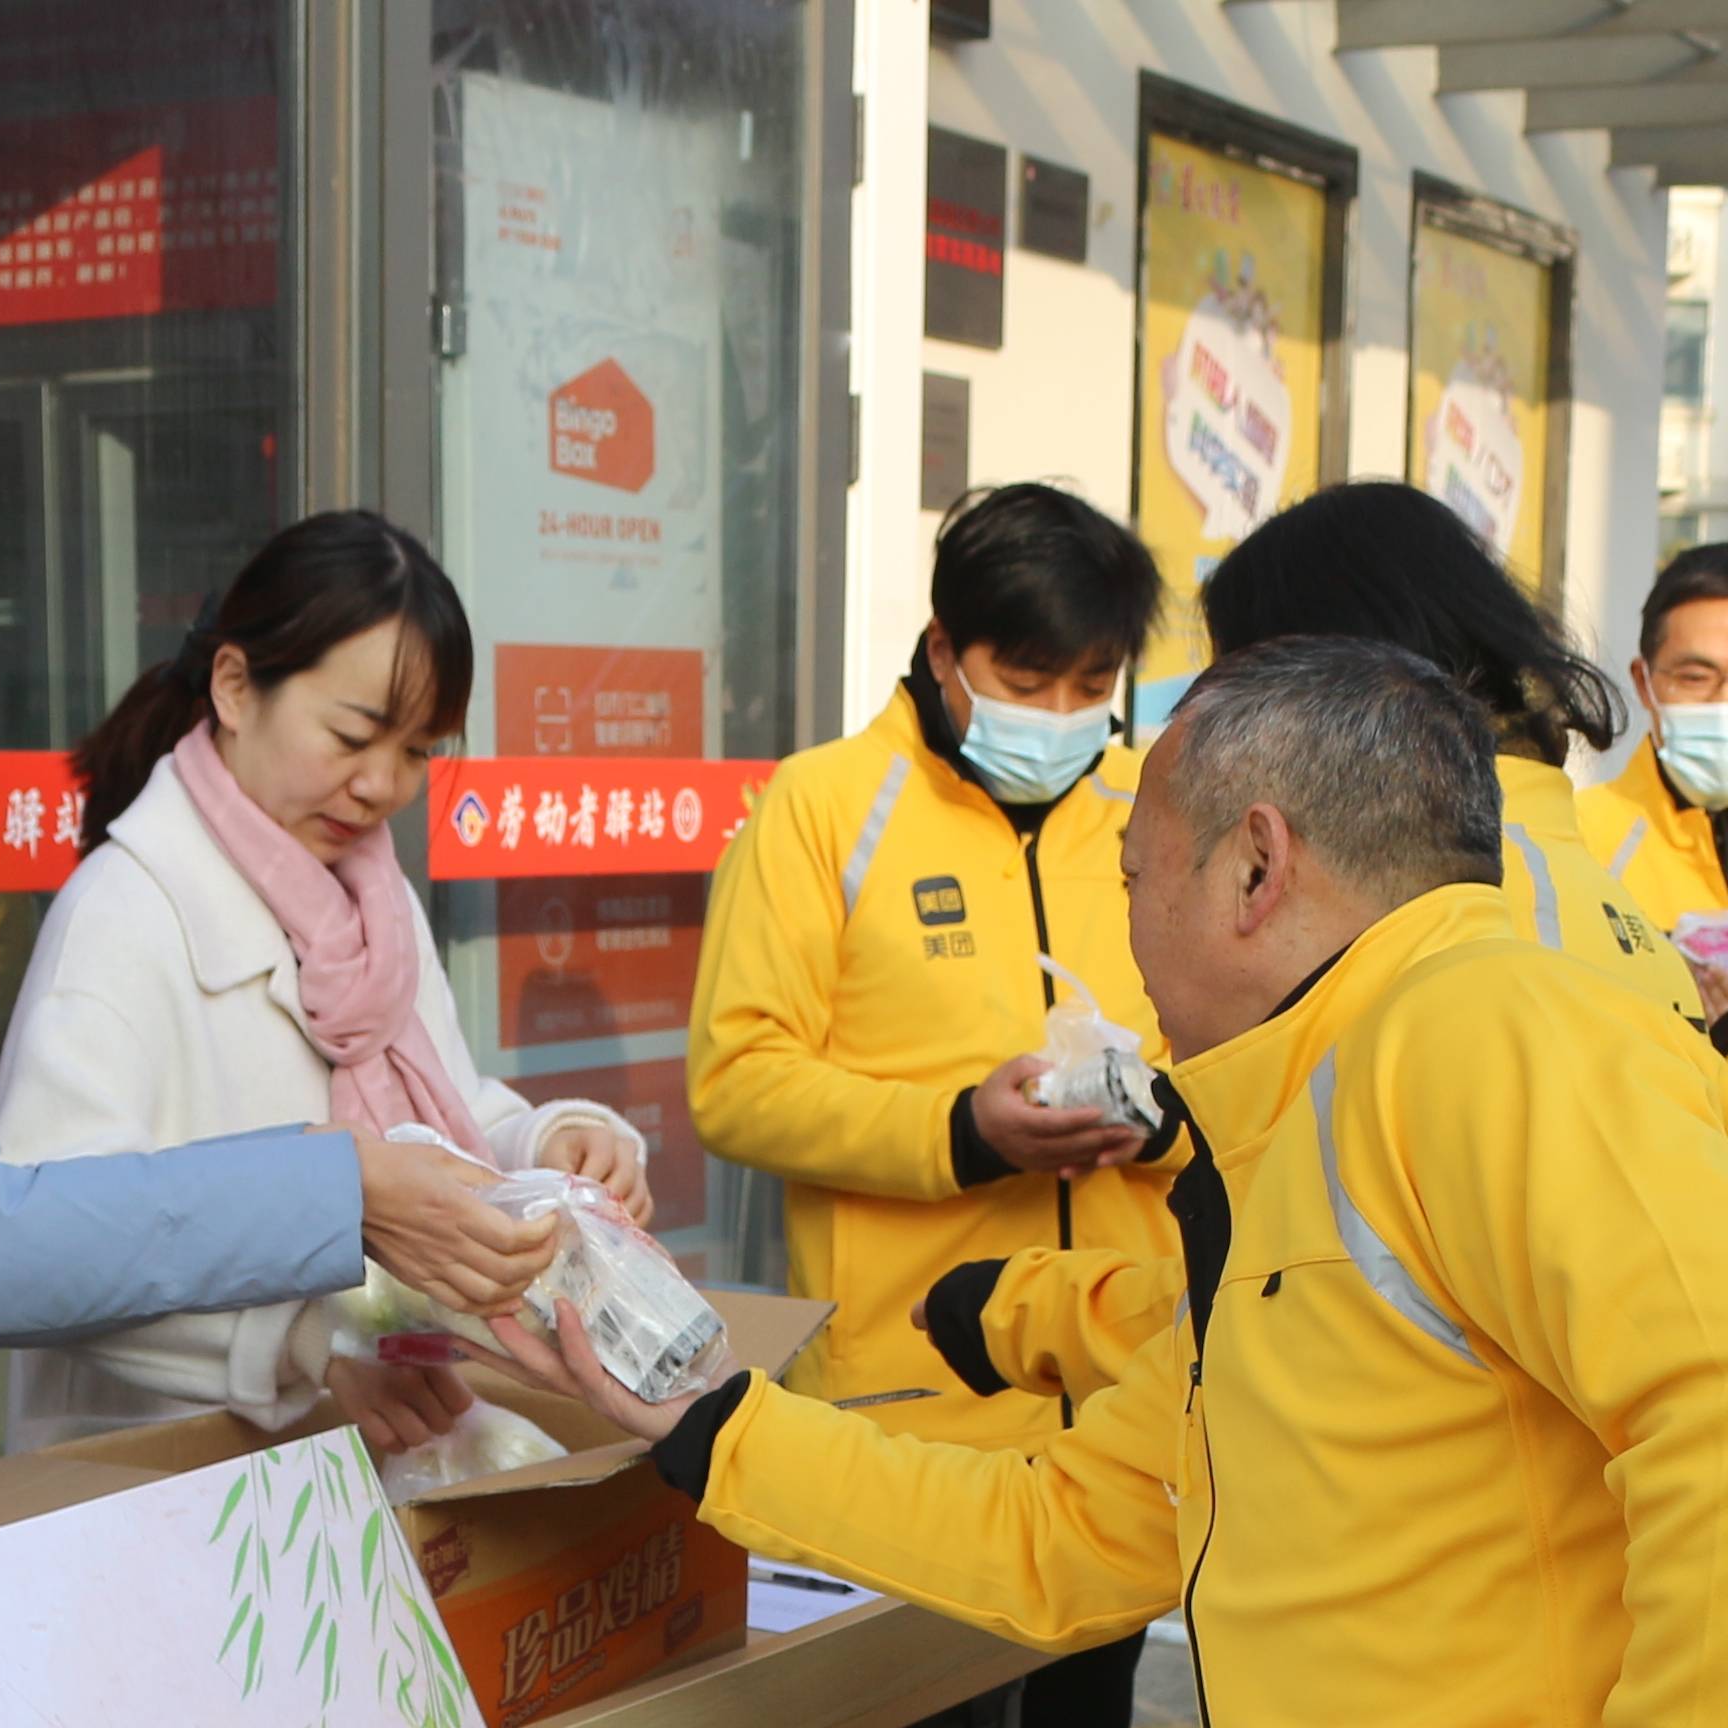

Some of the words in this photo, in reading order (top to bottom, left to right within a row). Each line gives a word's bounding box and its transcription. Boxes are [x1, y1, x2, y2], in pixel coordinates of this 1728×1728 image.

[555, 396, 617, 440] Bingo
[555, 437, 598, 469] Box
[497, 785, 666, 849] 劳动者驿站
[917, 887, 963, 915] 美团
[922, 931, 976, 963] 美团
[499, 1521, 684, 1708] 珍品鸡精
